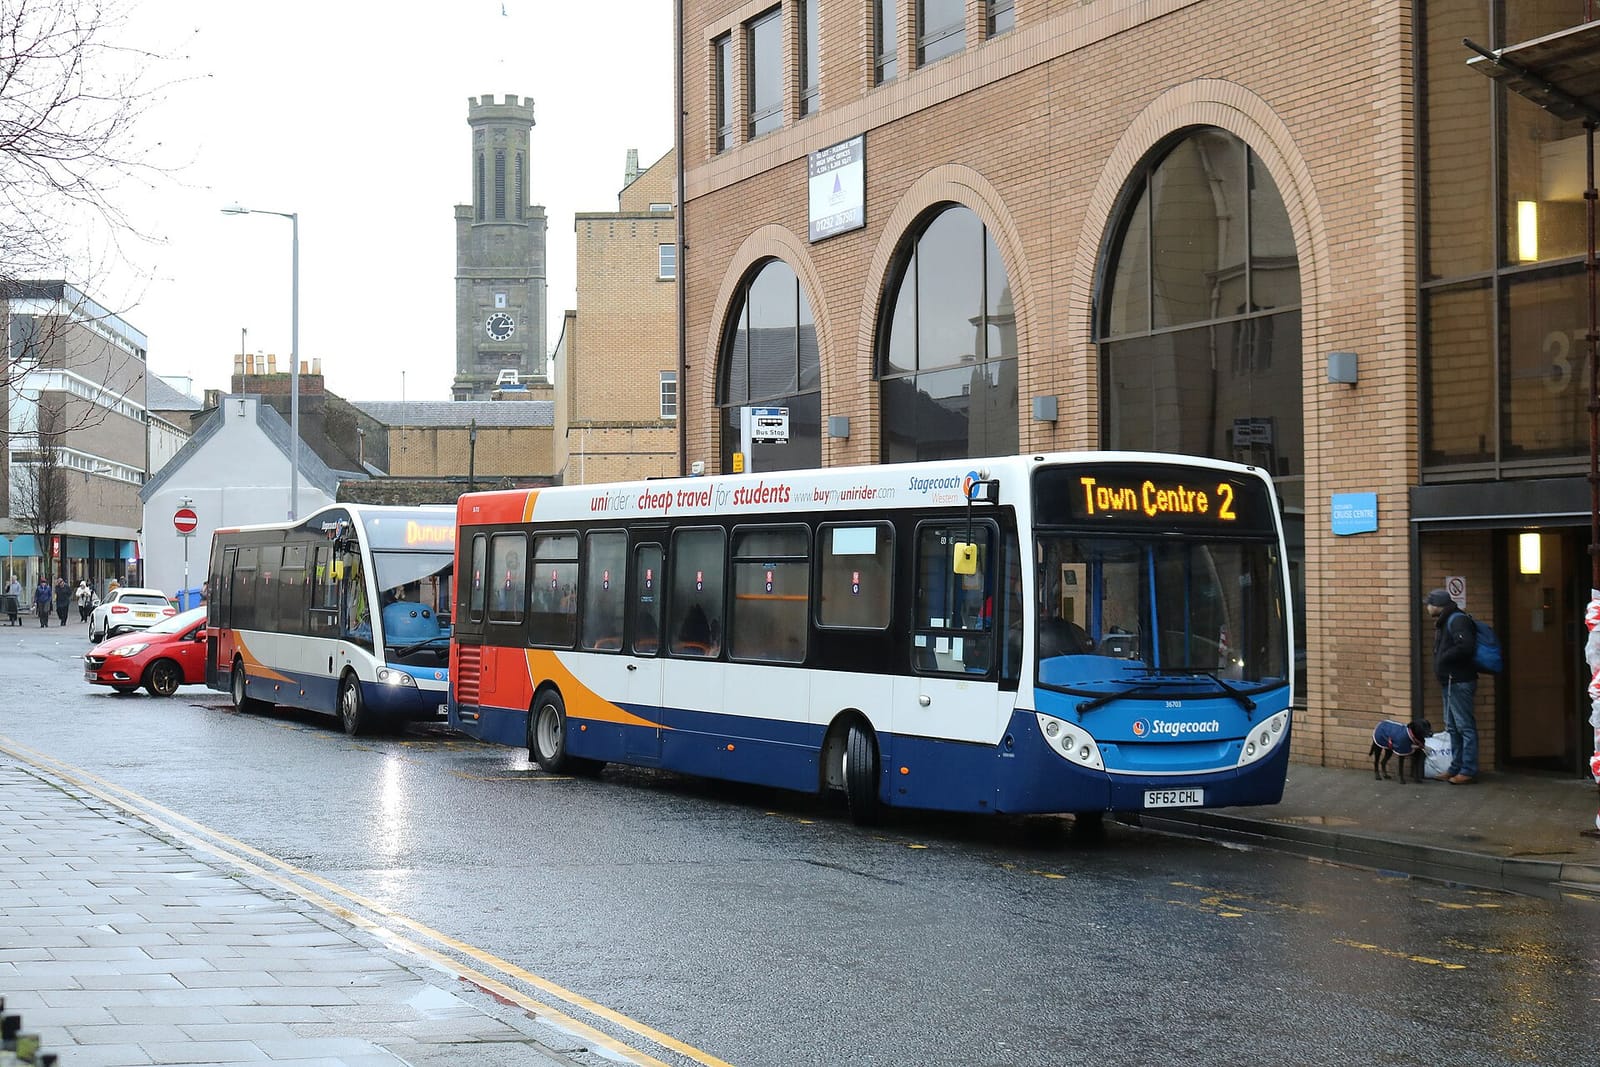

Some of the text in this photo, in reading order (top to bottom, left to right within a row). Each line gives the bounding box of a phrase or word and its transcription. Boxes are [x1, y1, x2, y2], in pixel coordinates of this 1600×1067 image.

[770, 429, 785, 437] Stop
[909, 475, 961, 494] Stagecoach
[638, 487, 673, 515] cheap
[677, 484, 714, 508] travel
[714, 482, 731, 512] for
[733, 480, 791, 506] students
[931, 492, 959, 504] Western
[1080, 476, 1237, 520] Town Centre 2
[1333, 509, 1374, 519] CRUISE CENTRE
[1152, 719, 1219, 737] Stagecoach
[1149, 791, 1199, 805] SF62 CHL
